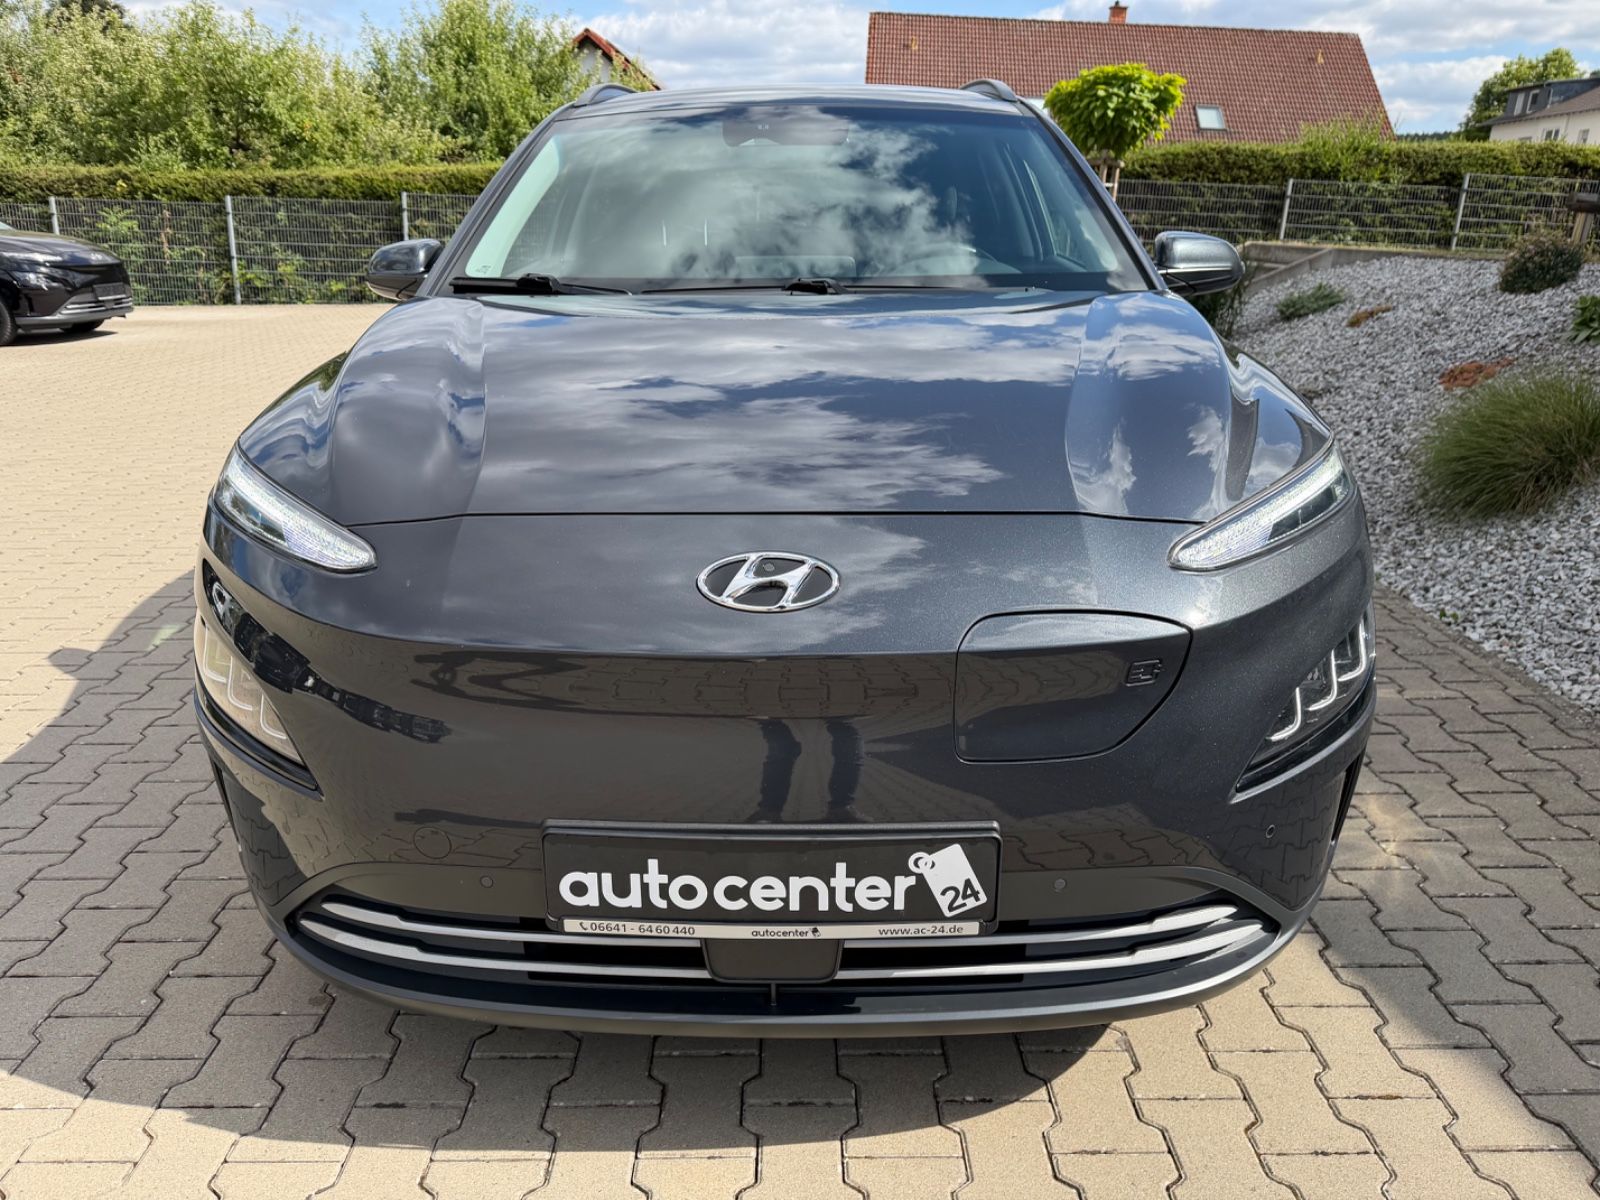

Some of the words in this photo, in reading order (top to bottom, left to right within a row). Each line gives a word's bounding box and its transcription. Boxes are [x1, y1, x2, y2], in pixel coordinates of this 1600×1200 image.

[559, 858, 916, 912] autocenter
[940, 877, 980, 912] 24
[589, 922, 626, 933] 06641
[751, 929, 809, 937] autocenter
[878, 925, 964, 936] www.ac-24.de
